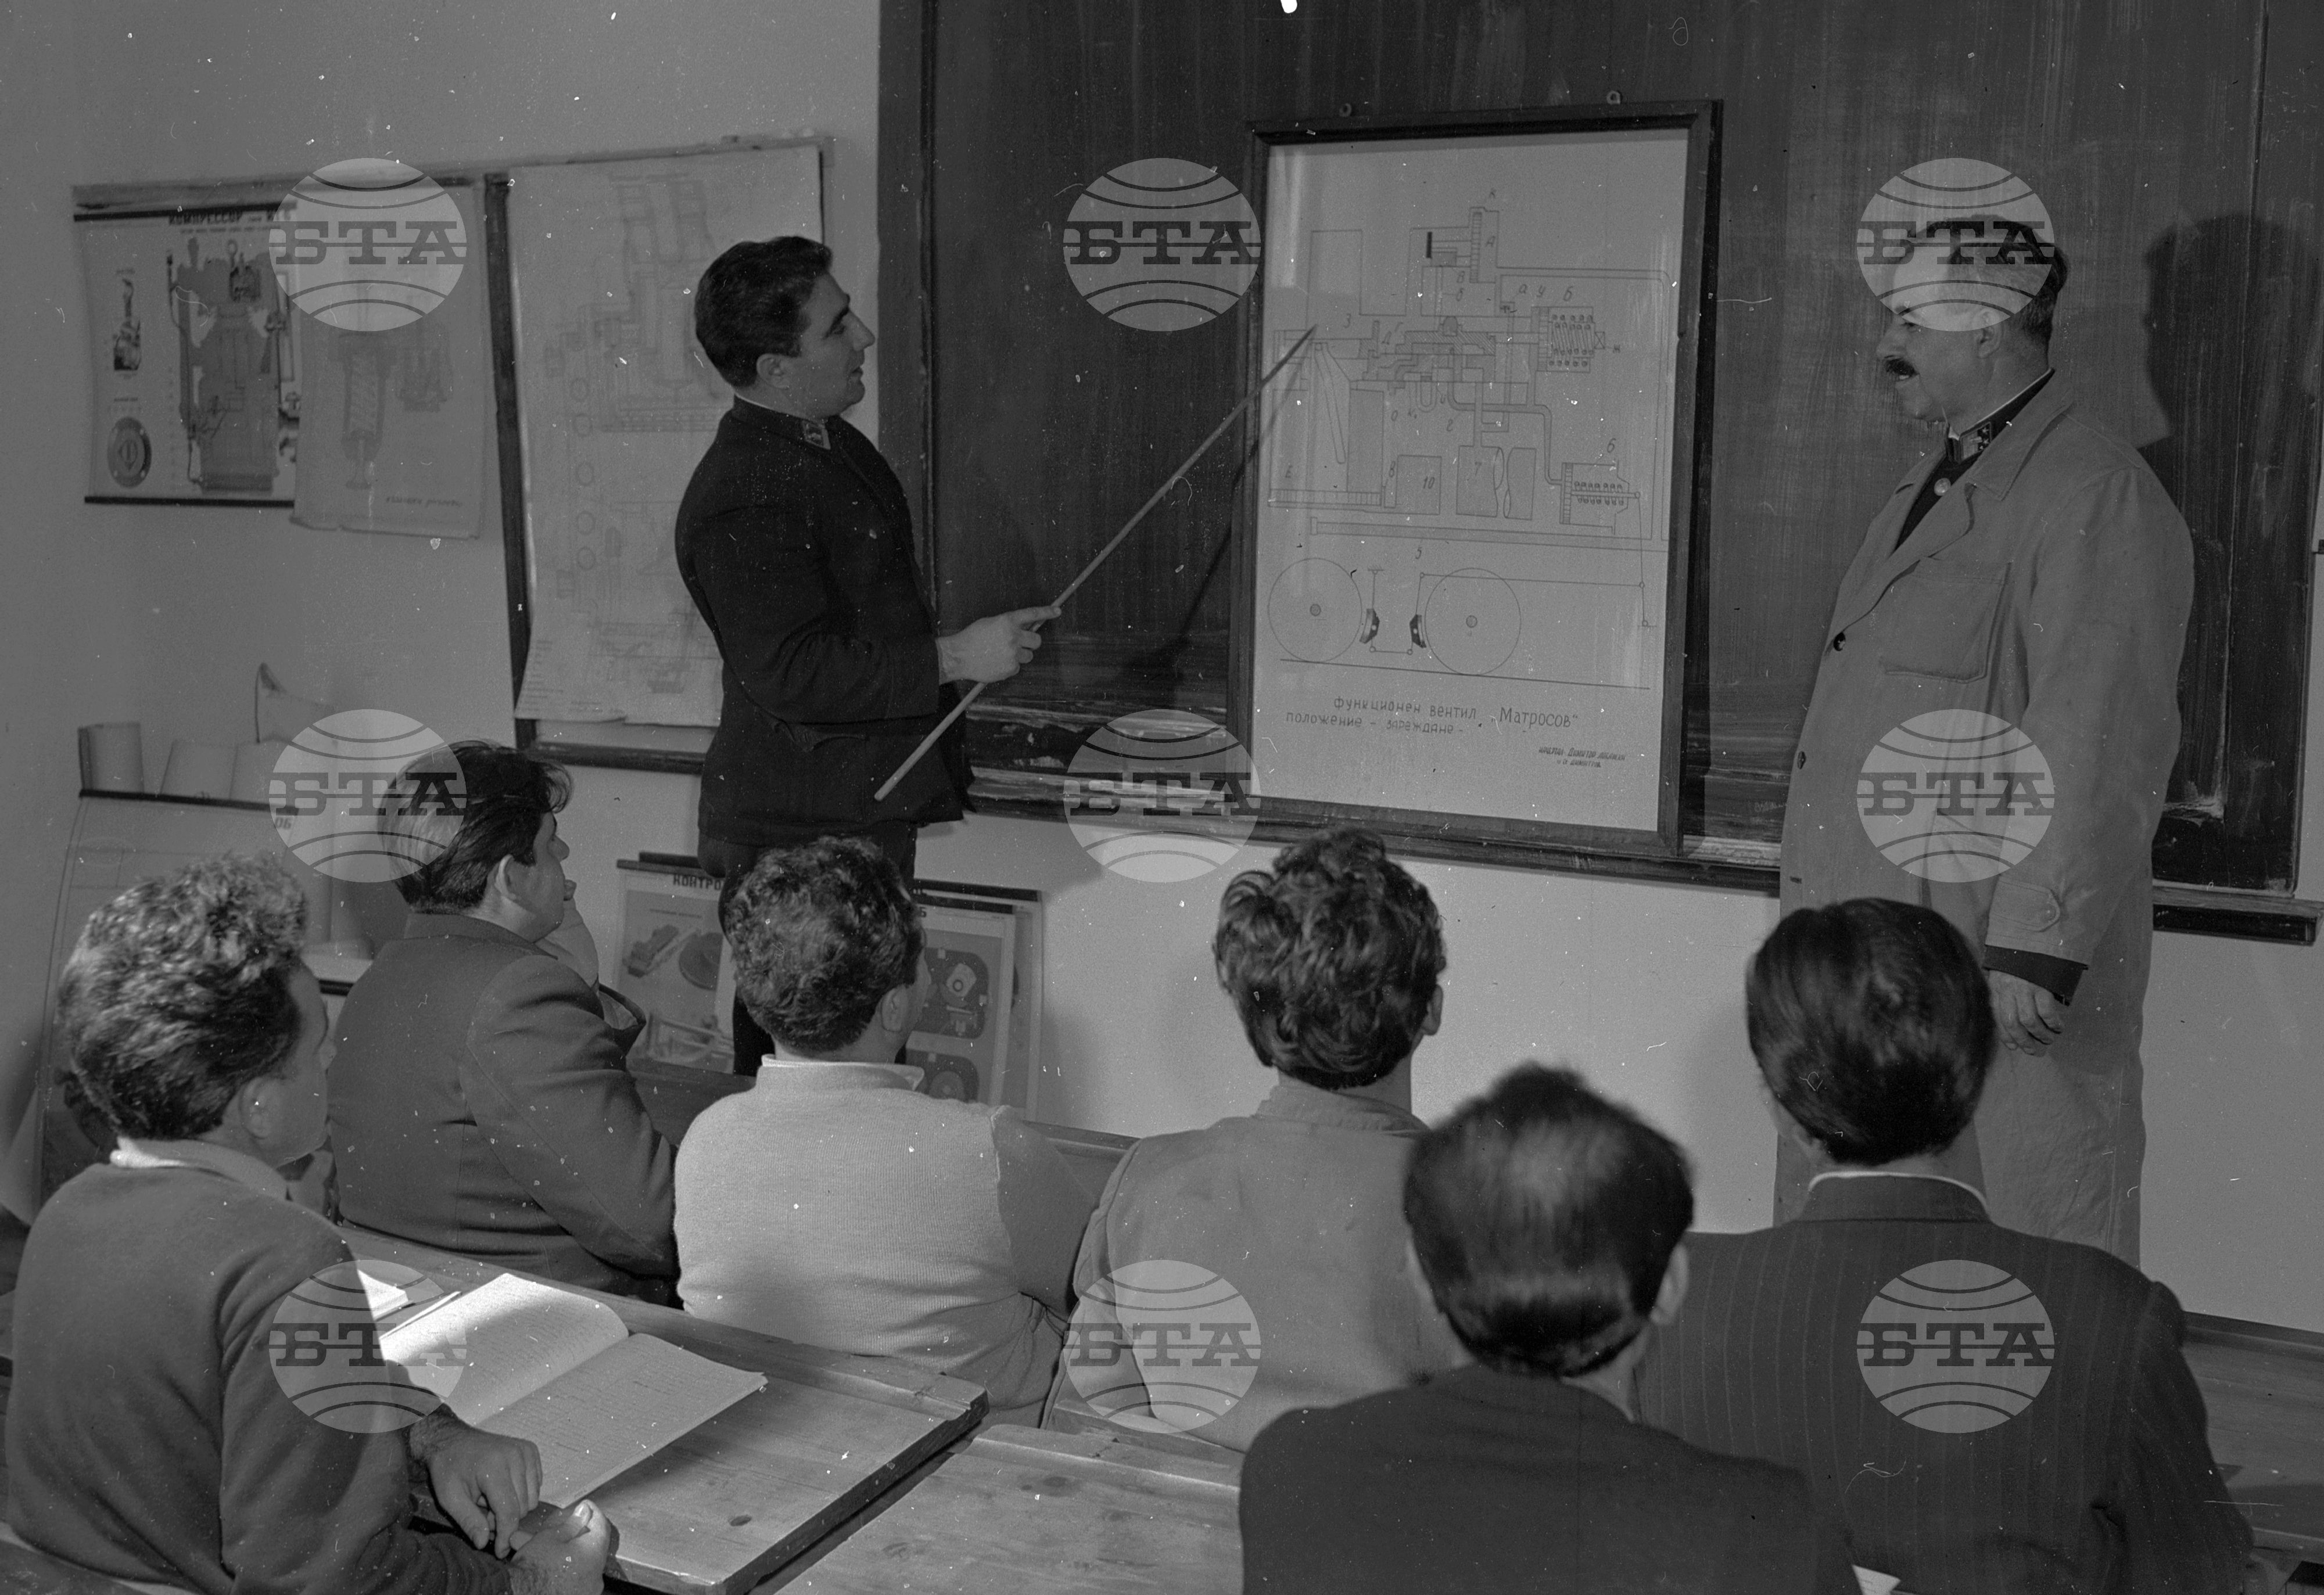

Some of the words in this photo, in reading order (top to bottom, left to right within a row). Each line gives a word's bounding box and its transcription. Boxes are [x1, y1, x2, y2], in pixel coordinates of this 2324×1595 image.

[1475, 461, 1482, 476] 7
[1422, 476, 1435, 489] 10
[1429, 705, 1476, 719] вентил
[1286, 712, 1362, 727] положение
